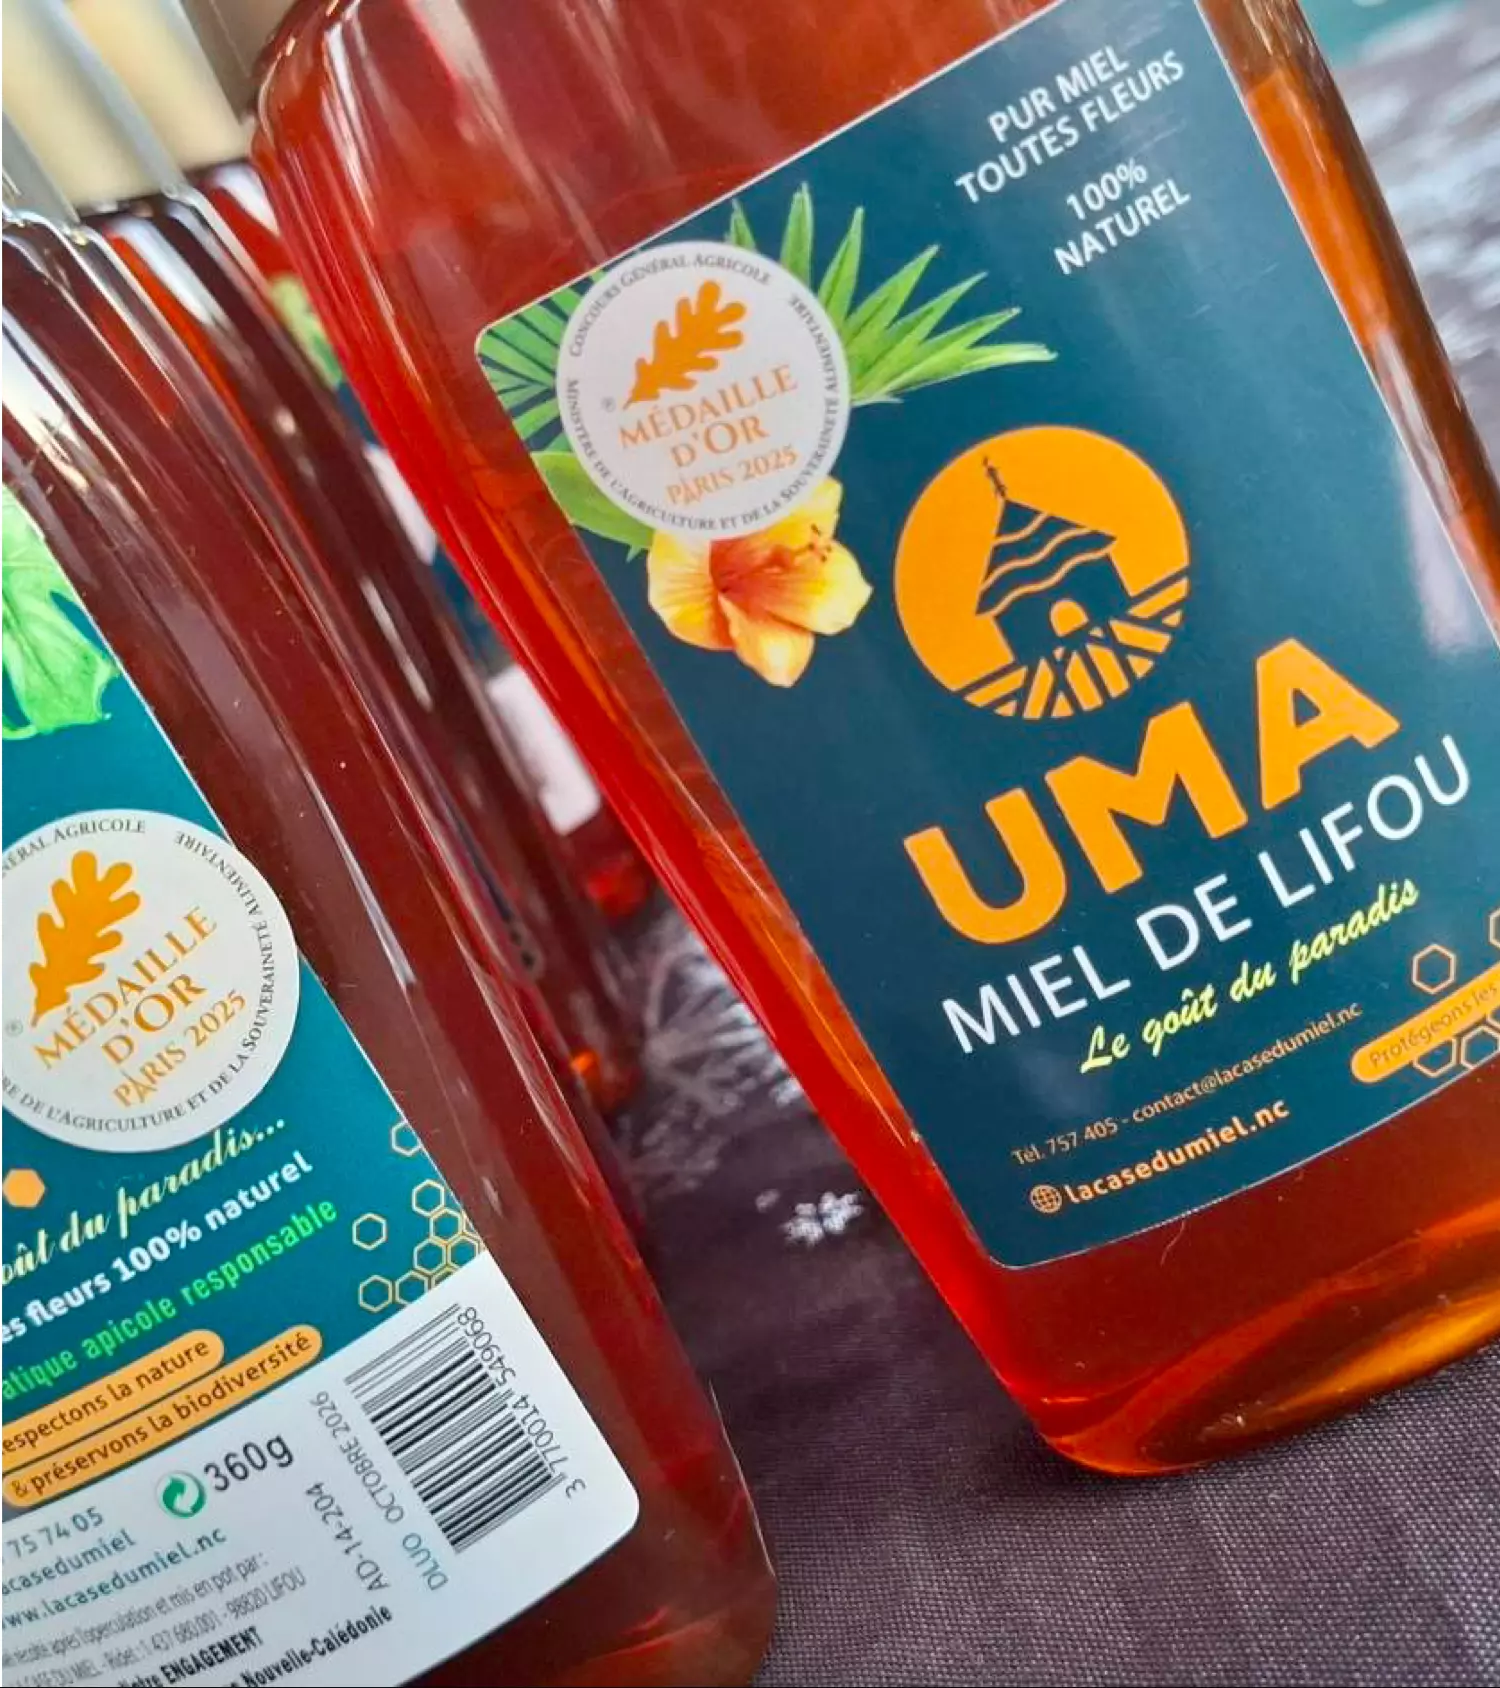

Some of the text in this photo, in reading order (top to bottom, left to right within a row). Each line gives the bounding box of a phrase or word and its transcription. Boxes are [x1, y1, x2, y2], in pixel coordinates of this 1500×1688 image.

[954, 50, 1184, 203] TOUTES FLEURS
[988, 46, 1130, 143] PUR MIEL
[1053, 179, 1191, 275] NATUREL
[1067, 158, 1147, 220] 100%
[569, 285, 622, 357] CONCOURS
[692, 255, 771, 286] AGRICOLE
[593, 460, 610, 481] DE
[610, 479, 717, 531] L'AGRICULTURE
[720, 515, 737, 530] ET
[741, 508, 761, 524] DE
[762, 500, 781, 517] LA
[788, 295, 838, 394] ALIMENTAIRE
[619, 365, 797, 449] MÉDAILLE
[670, 415, 769, 467] D'OR
[666, 447, 797, 507] PARIS 2025
[53, 820, 146, 845] AGRICOLE
[903, 638, 1400, 944] UMA
[175, 831, 262, 917] ALIMENTAIRE
[941, 734, 1470, 1054] MIEL DE LIFOU
[33, 906, 217, 1069] MÉDAILLE
[102, 973, 206, 1064] D'OR
[1080, 879, 1419, 1074] Le goût du paradis
[113, 989, 246, 1108] PARIS 2025
[230, 1053, 250, 1073] LA
[1046, 1131, 1077, 1156] 757
[1084, 1117, 1118, 1141] 405
[1132, 1002, 1363, 1123] contact@lacasedumiel.nc
[1370, 1001, 1472, 1068] Protégeons
[21, 1092, 43, 1114] DE
[47, 1102, 187, 1132] L'AGRICULTURE
[187, 1090, 207, 1111] ET
[208, 1070, 231, 1093] DE
[60, 1210, 109, 1253] du
[115, 1119, 285, 1239] paradis...
[1063, 1099, 1290, 1204] lacasedumiel.nc
[2, 1150, 313, 1343] es fleurs 100% naturel
[2, 1201, 338, 1399] atique apicole responsable
[11, 1333, 312, 1498] & préservons la biodiversité
[108, 1383, 133, 1402] la
[136, 1341, 210, 1390] nature
[457, 1306, 587, 1499] 3 770014 549068
[204, 1434, 294, 1492] 360g
[309, 1391, 448, 1591] DLUO OCTOBRE 2026
[7, 1506, 104, 1558] 75 74 05
[2, 1527, 227, 1630] ww.lacasedumiel.nc
[193, 1578, 214, 1598] en
[211, 1565, 234, 1593] pot
[264, 1566, 306, 1601] LIFOU
[160, 1625, 264, 1684] ENGAGEMENT
[240, 1604, 393, 1687] Nouvelle-Calédonie
